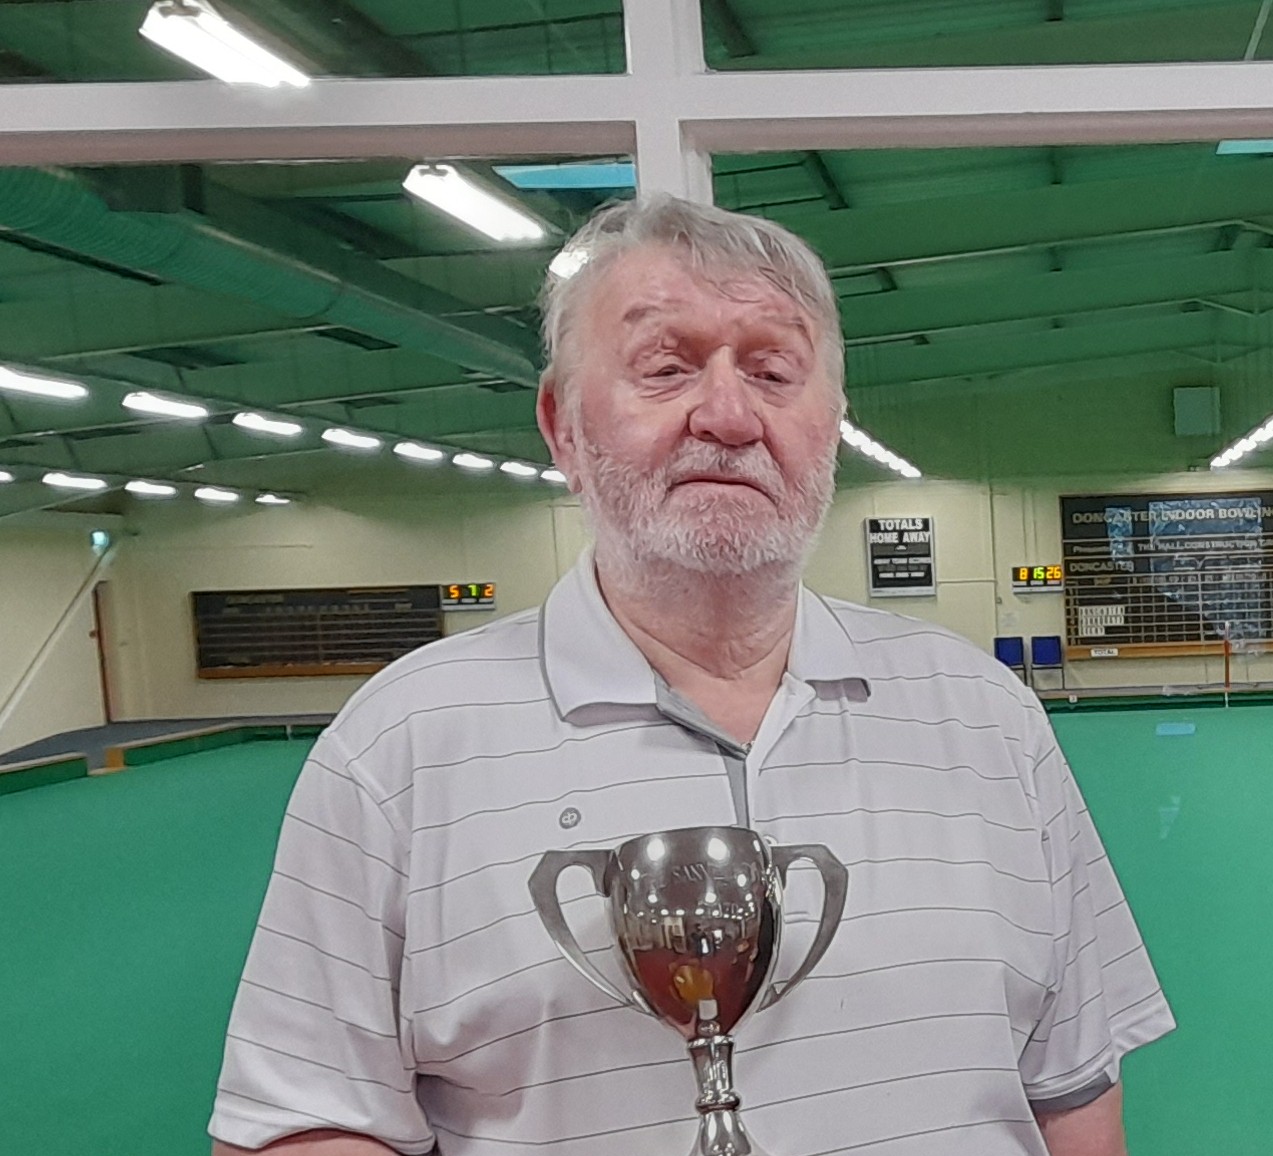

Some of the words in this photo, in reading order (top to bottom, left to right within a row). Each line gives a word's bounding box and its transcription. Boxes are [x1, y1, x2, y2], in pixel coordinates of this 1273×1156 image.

[878, 519, 923, 530] TOTALS
[869, 532, 899, 543] HOME
[902, 532, 931, 543] AWAY
[1046, 566, 1062, 579] 26
[449, 585, 459, 598] 5
[484, 584, 493, 597] 2
